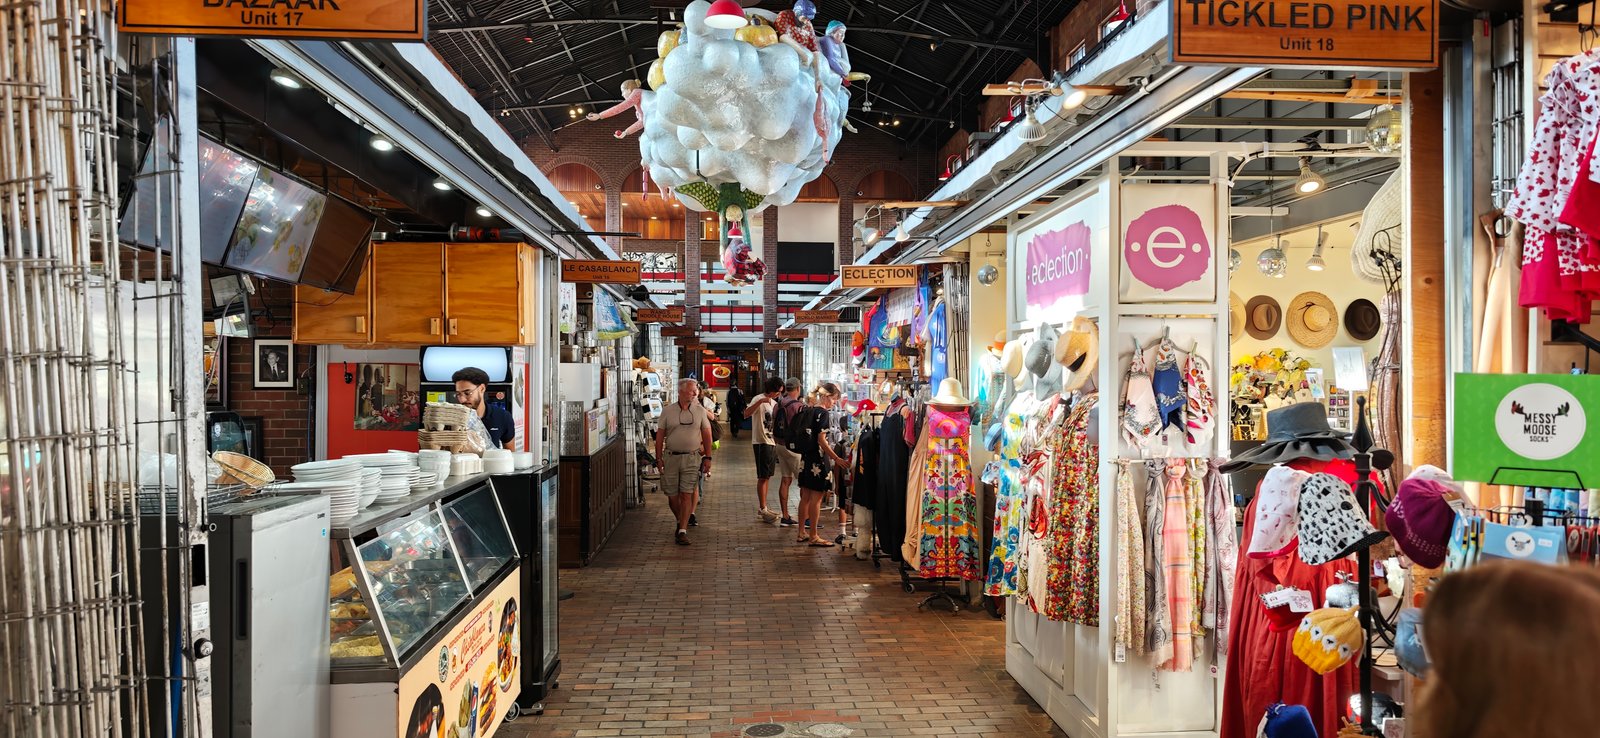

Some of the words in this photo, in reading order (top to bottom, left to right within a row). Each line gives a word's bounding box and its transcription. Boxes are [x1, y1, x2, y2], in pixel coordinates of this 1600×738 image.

[241, 11, 277, 25] Unit
[283, 12, 303, 25] 17
[1186, 0, 1334, 28] TICKLED
[1347, 4, 1426, 31] PINK
[1280, 37, 1312, 50] Unit
[1316, 38, 1334, 51] 18
[1147, 226, 1186, 268] e
[578, 265, 638, 273] CASABLANCA
[1031, 247, 1083, 286] eclection
[844, 269, 914, 279] ECLECTION
[1524, 413, 1557, 424] MESSY
[1523, 424, 1557, 436] MOOSE
